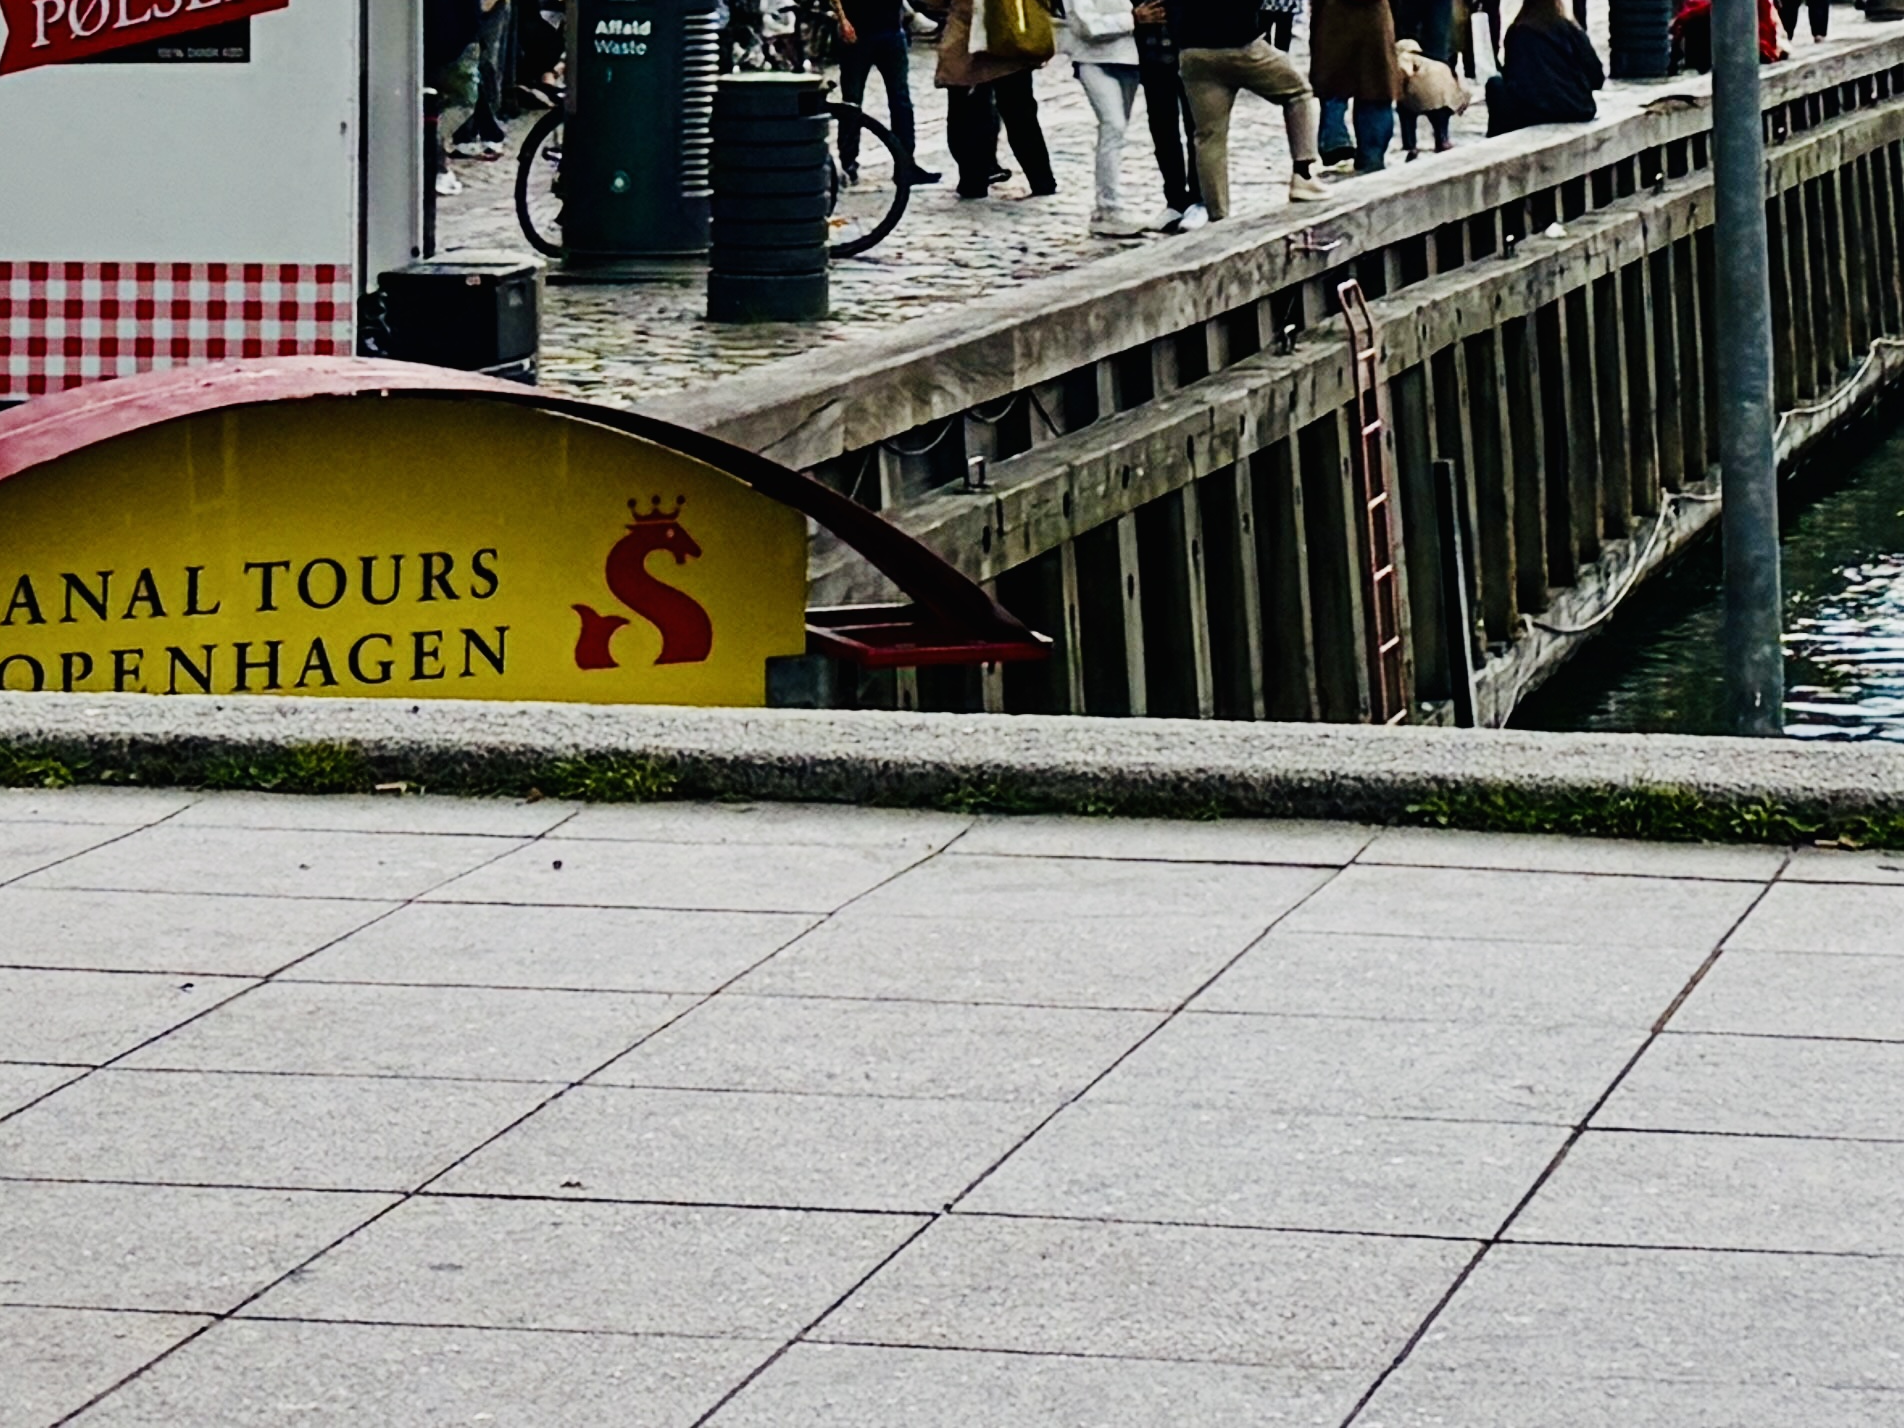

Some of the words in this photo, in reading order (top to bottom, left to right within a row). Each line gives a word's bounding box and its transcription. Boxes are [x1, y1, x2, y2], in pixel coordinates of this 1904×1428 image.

[595, 19, 652, 36] Affald
[594, 39, 647, 56] Waste
[243, 547, 501, 613] TOURS
